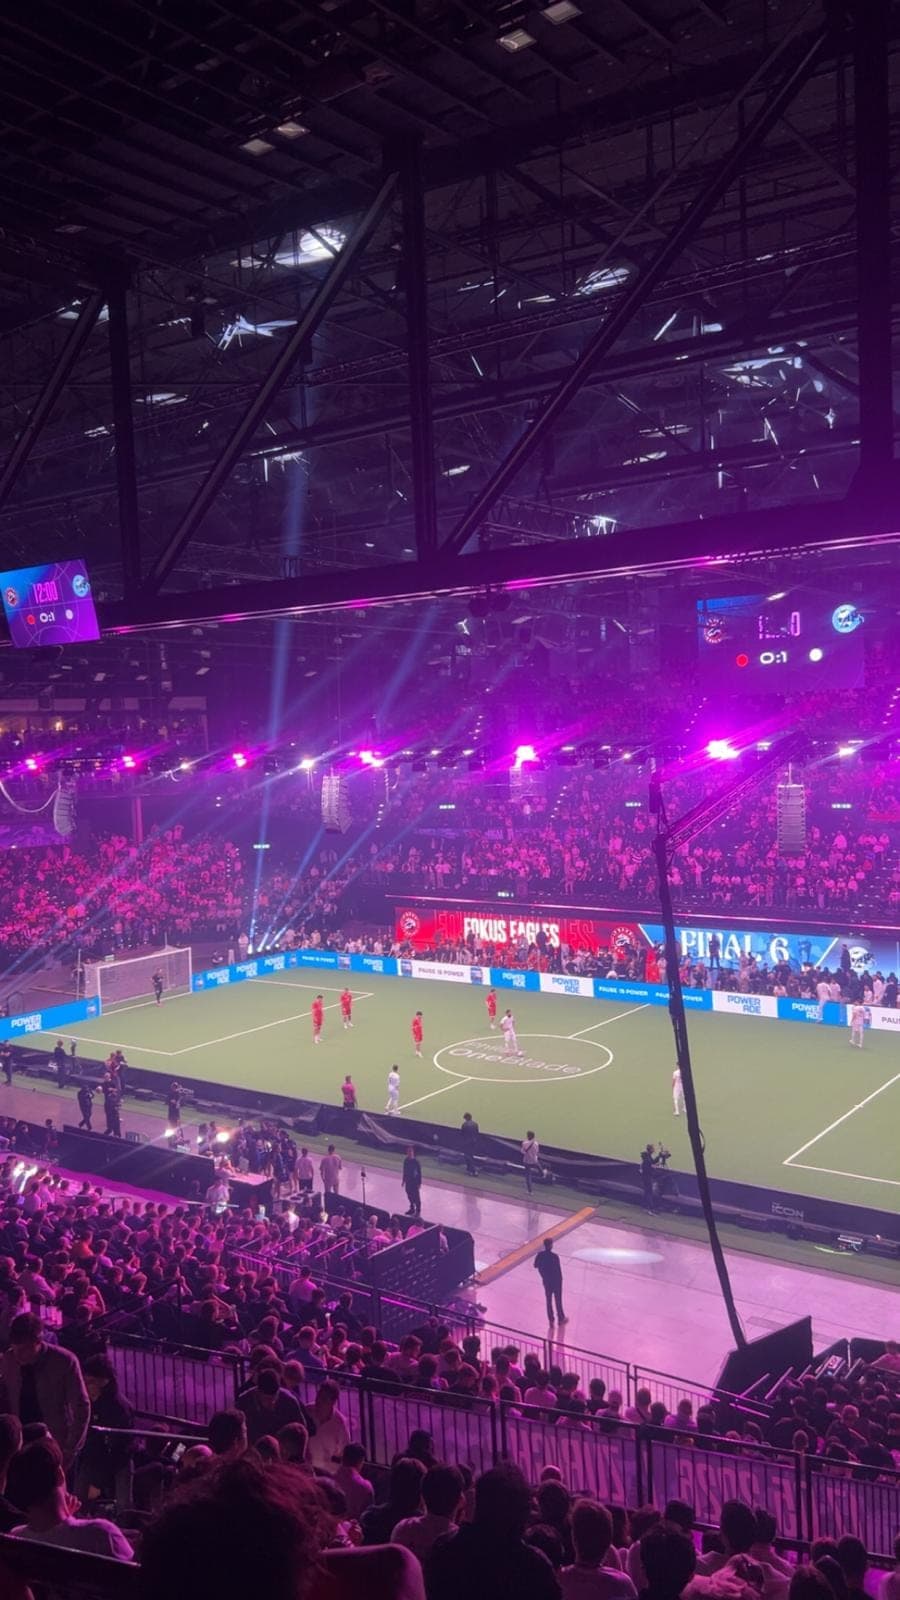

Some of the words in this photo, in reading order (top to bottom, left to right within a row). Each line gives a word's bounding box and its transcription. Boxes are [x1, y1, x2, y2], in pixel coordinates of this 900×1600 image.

[40, 611, 55, 623] 0:1
[760, 651, 787, 664] 0:1
[463, 917, 507, 943] FOKUS
[770, 936, 790, 965] 6
[552, 977, 580, 986] POWER
[728, 995, 760, 1006] POWER
[449, 1048, 582, 1074] OneBlade
